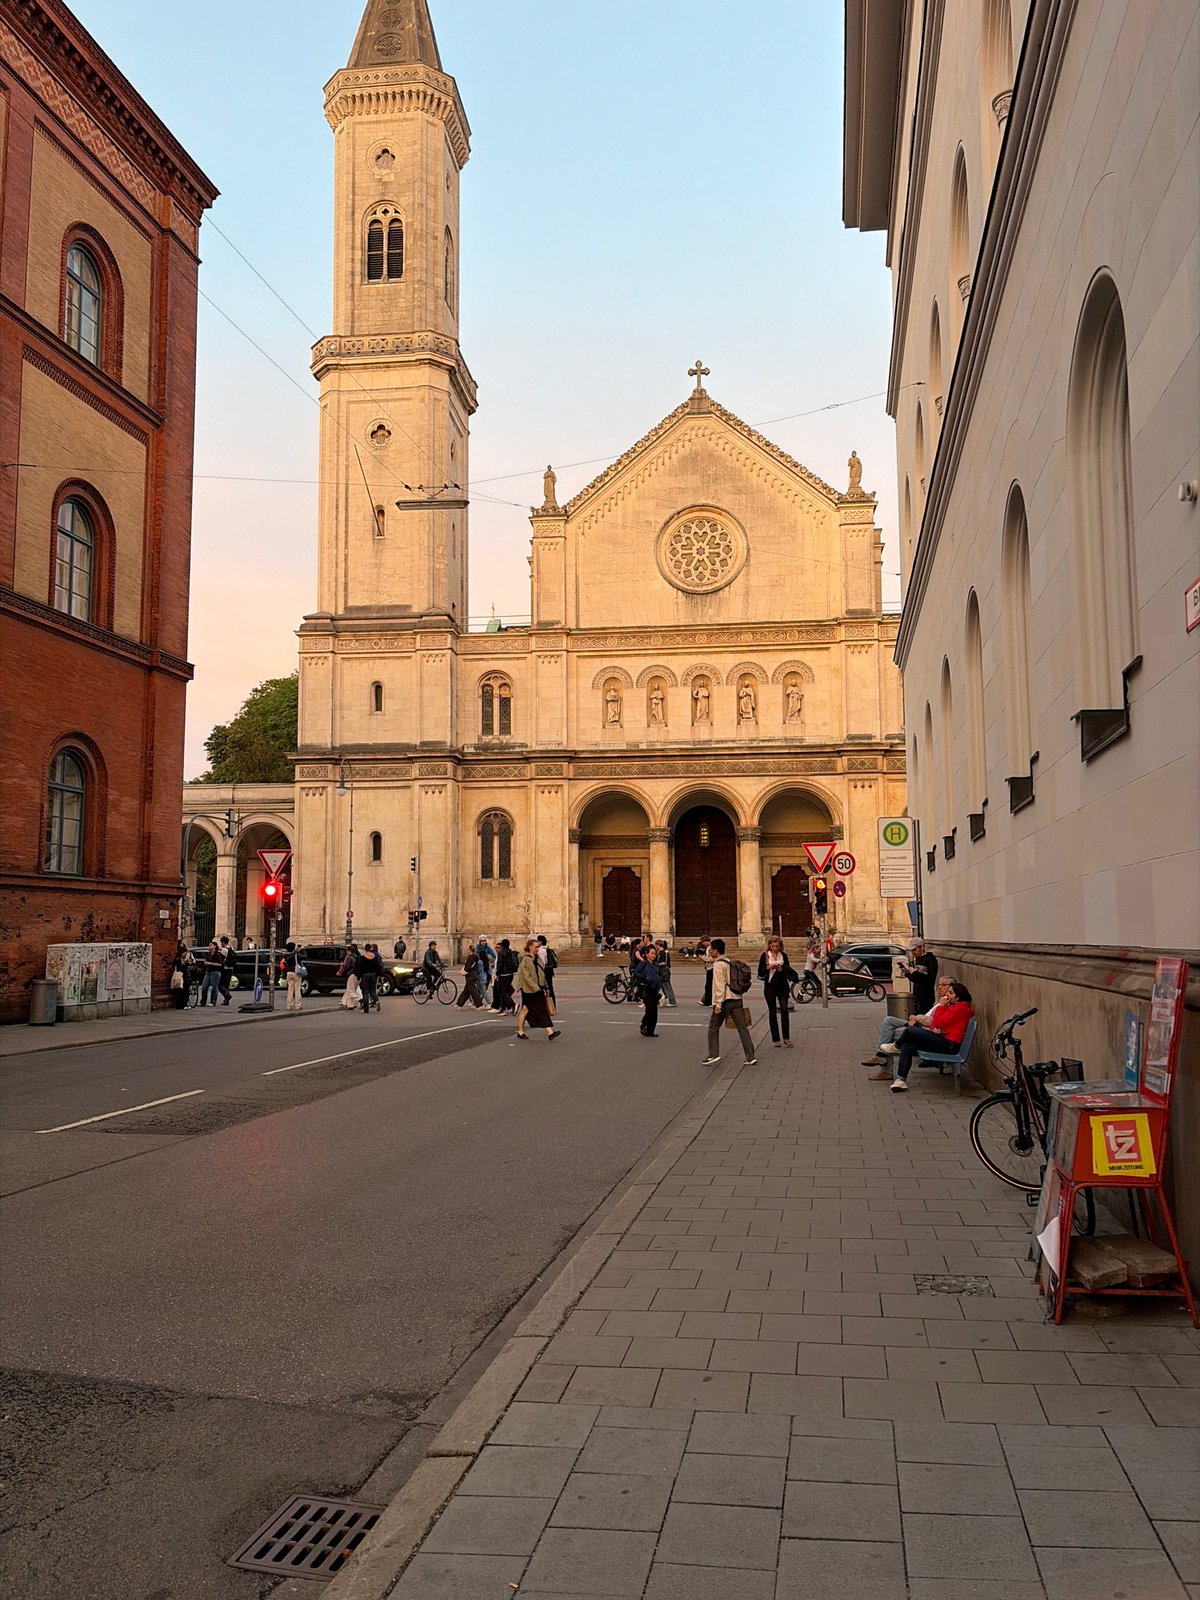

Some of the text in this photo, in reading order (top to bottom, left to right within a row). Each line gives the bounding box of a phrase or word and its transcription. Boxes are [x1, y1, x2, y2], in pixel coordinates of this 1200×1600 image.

[890, 826, 901, 841] H
[837, 858, 851, 870] 50
[1105, 1124, 1138, 1160] tz
